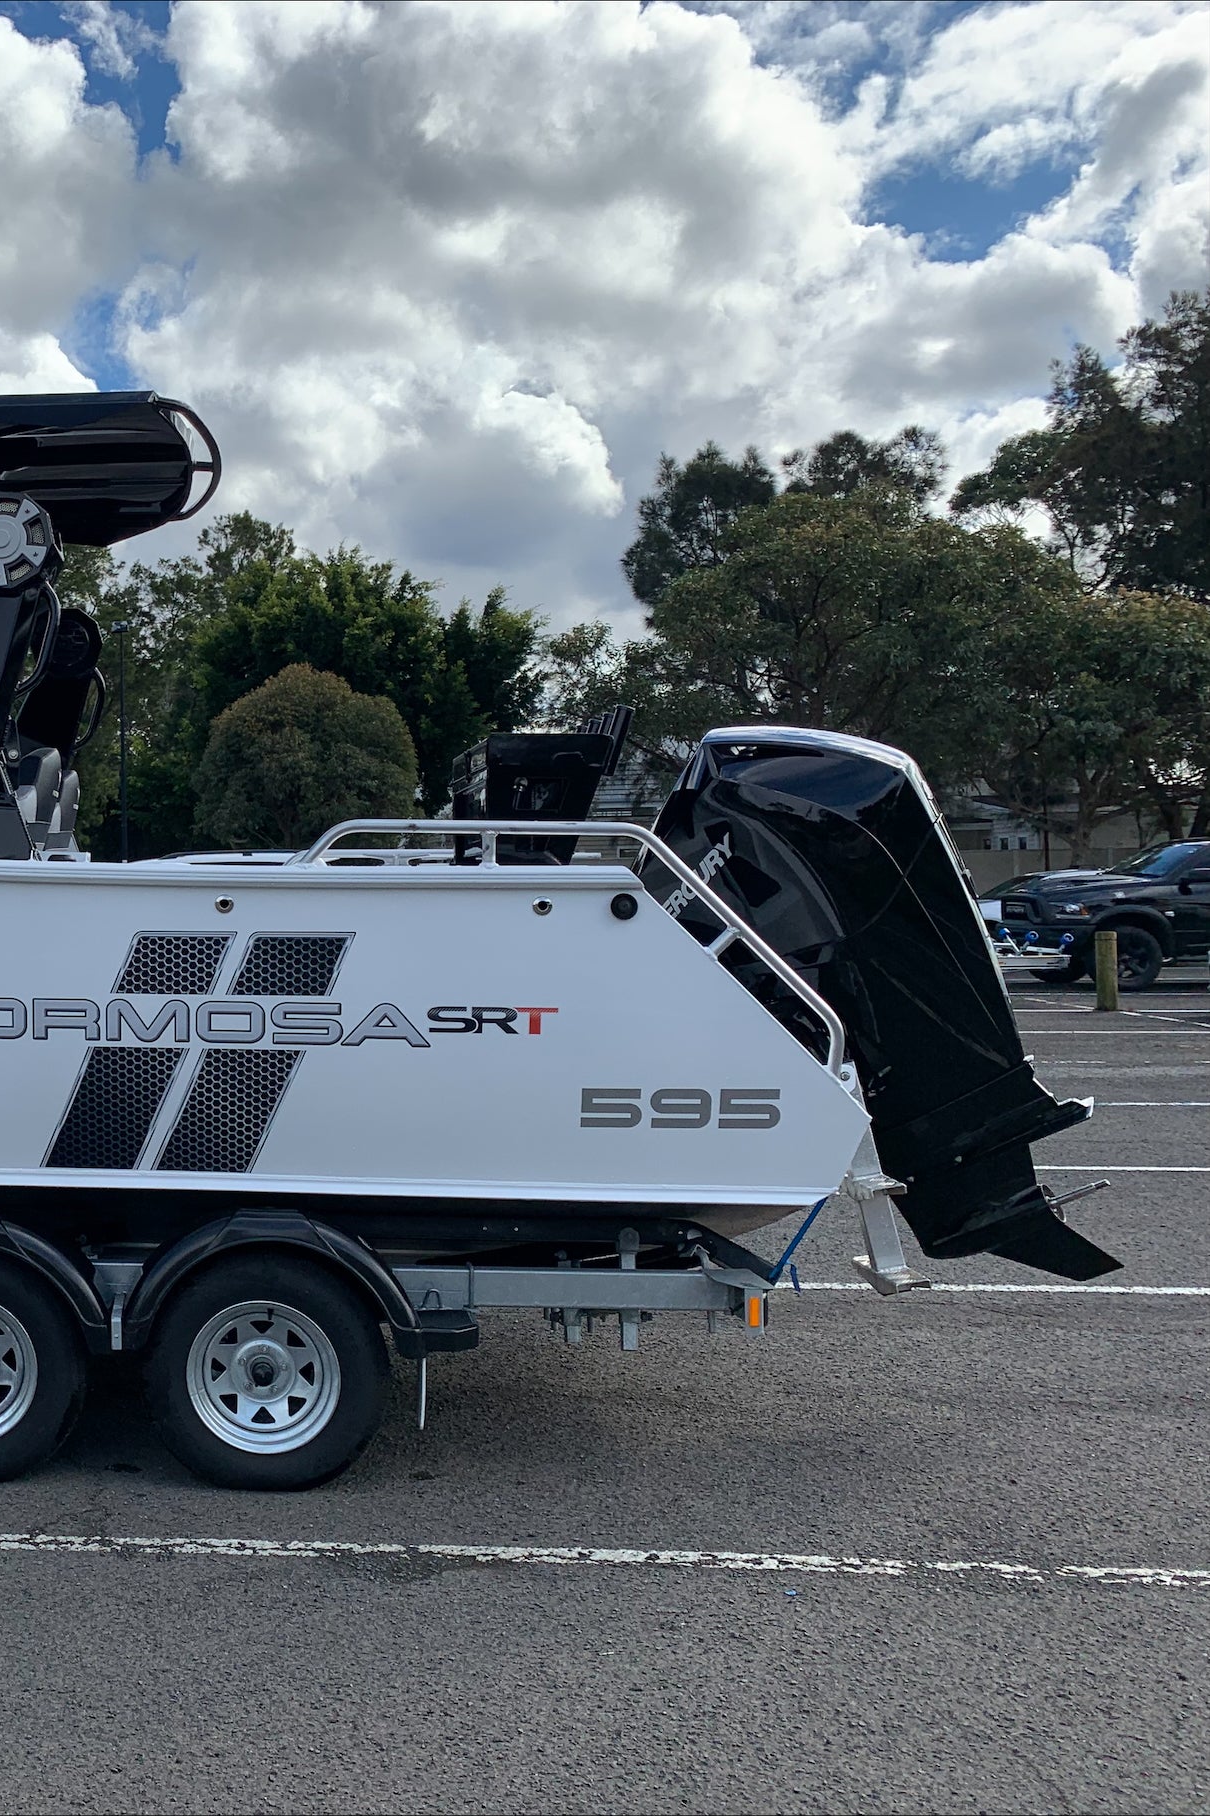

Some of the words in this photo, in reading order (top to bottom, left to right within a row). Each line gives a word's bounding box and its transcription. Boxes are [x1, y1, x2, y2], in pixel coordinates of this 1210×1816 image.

[661, 831, 733, 919] ERCURY
[428, 1006, 558, 1035] SRT
[580, 1088, 781, 1129] 595
